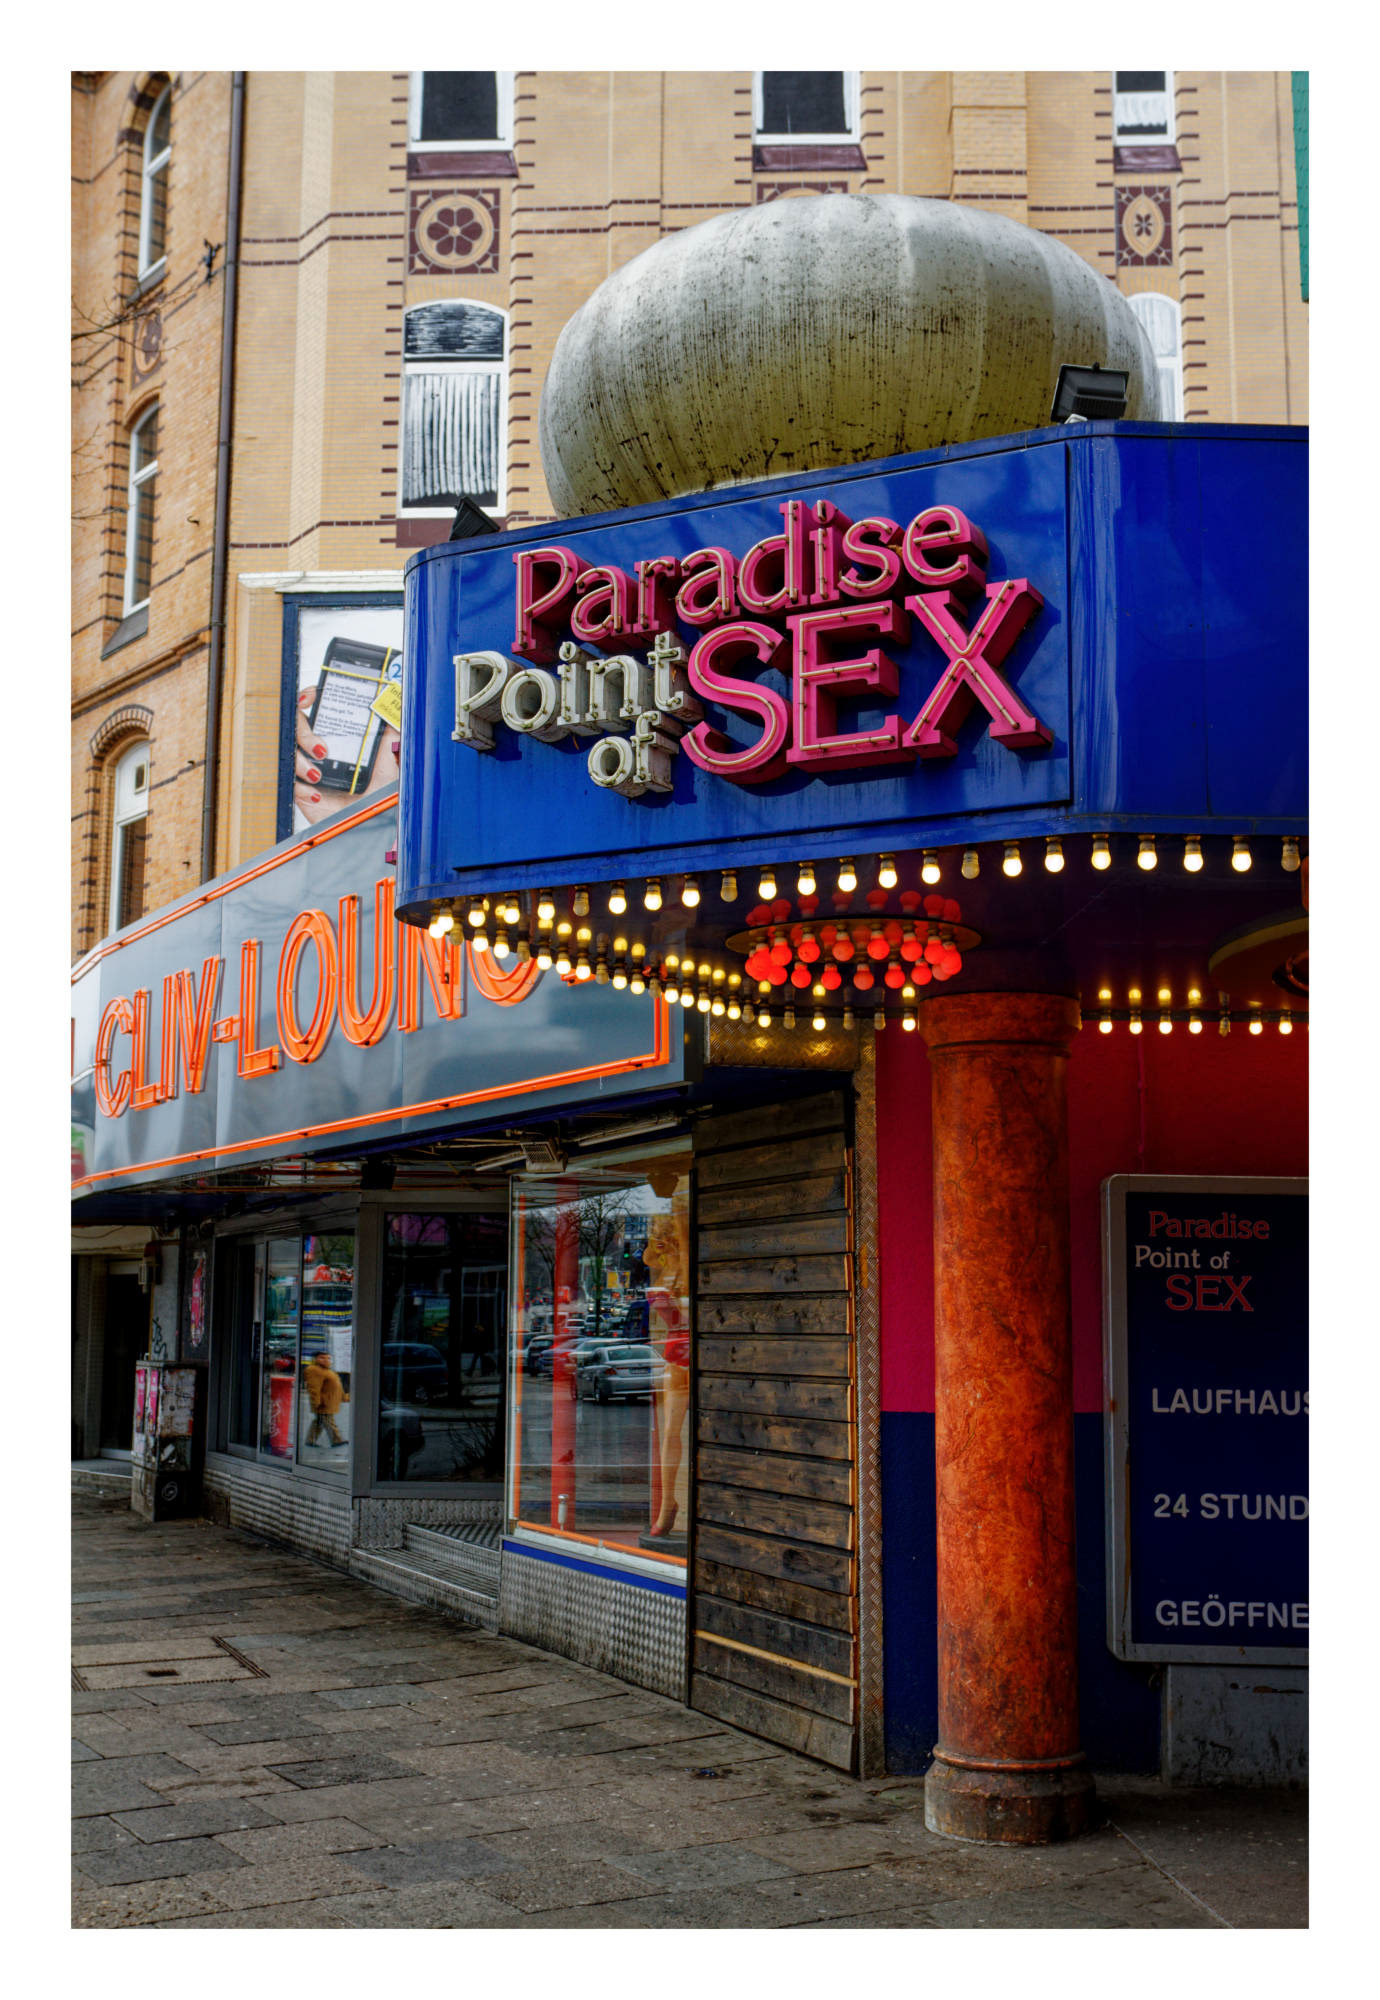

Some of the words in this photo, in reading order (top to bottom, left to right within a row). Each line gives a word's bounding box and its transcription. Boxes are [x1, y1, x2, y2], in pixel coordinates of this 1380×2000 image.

[512, 500, 987, 660] Paradise
[452, 631, 700, 750] Point
[681, 579, 1052, 782] SEX
[588, 711, 678, 793] of
[1147, 1209, 1270, 1240] Paradise
[1134, 1245, 1201, 1269] Point
[1209, 1250, 1231, 1270] of
[1165, 1274, 1254, 1312] SEX
[1153, 1492, 1190, 1519] 24
[1199, 1492, 1309, 1521] STUND
[1155, 1593, 1309, 1629] GEÖFFNE
